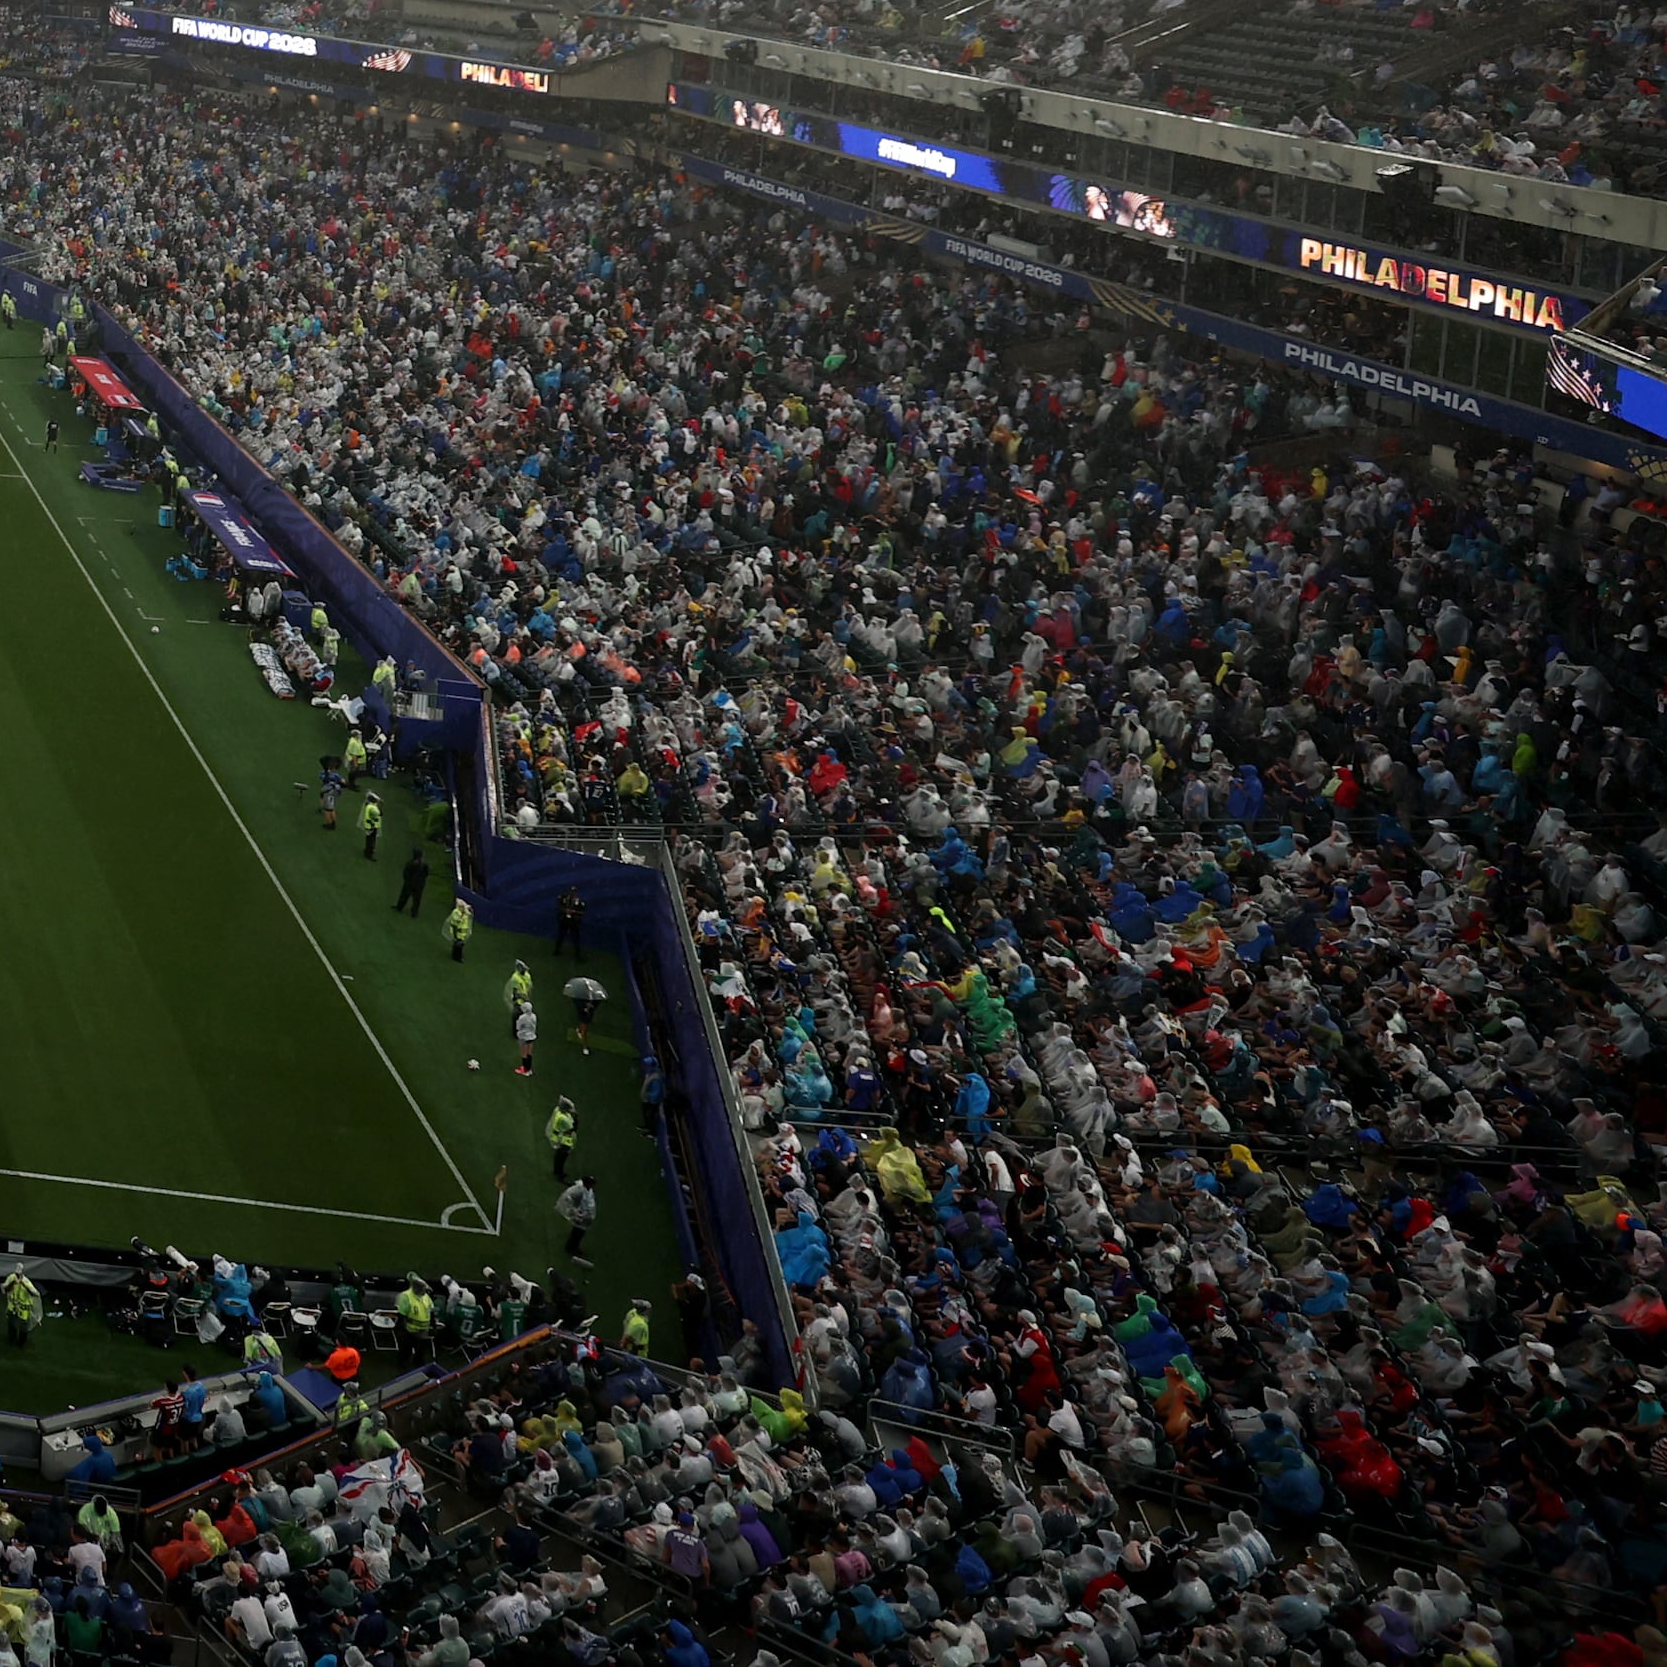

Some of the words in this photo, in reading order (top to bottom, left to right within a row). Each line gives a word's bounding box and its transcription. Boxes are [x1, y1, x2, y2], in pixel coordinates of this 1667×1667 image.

[172, 17, 197, 36] FIFA
[197, 21, 241, 43] WORLD
[242, 28, 267, 48] CUP
[267, 32, 317, 56] 2026
[264, 74, 335, 94] PHILADELPHIA
[723, 170, 806, 205] PHILADELPHIA
[946, 239, 967, 257] FIFA
[967, 246, 1003, 269] WORLD
[1003, 255, 1025, 275] CUP
[1025, 265, 1063, 287] 2026
[23, 282, 38, 296] FIFA
[1301, 237, 1565, 332] PHILADELPHIA
[1283, 342, 1482, 417] PHILADELPHIA
[513, 1608, 527, 1625] 10
